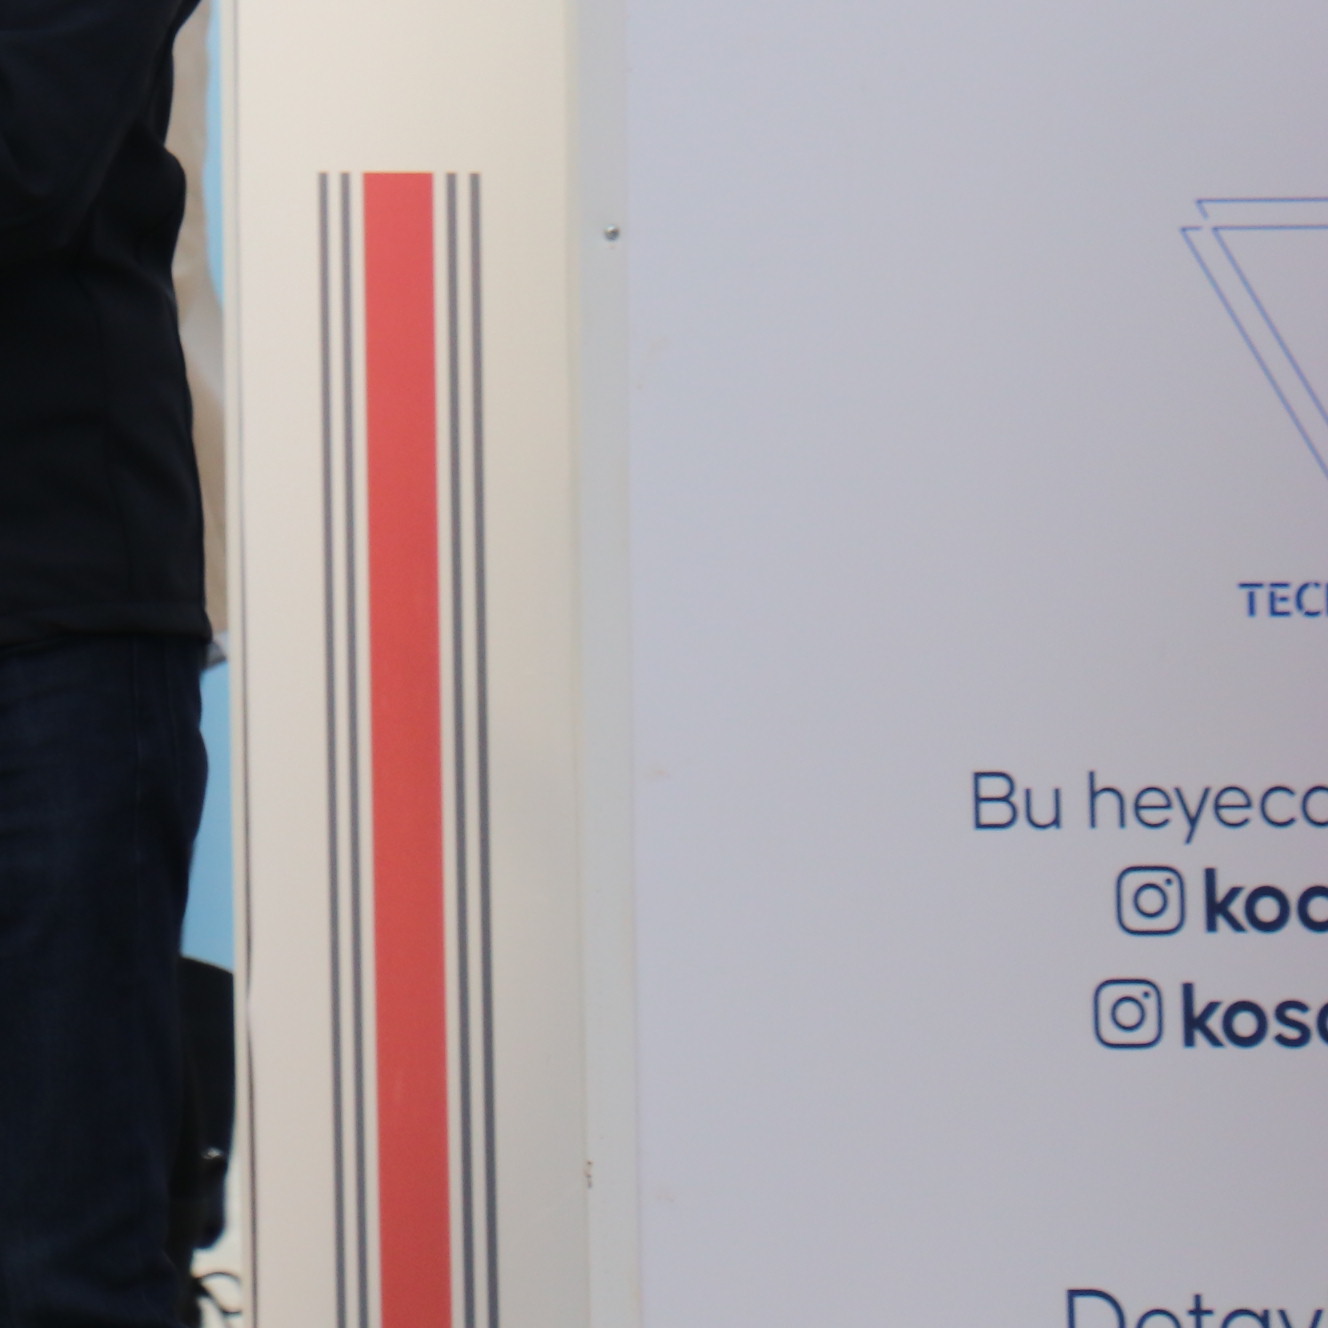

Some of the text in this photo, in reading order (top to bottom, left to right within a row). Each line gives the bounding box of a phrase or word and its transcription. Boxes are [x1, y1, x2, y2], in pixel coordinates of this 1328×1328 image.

[1237, 581, 1328, 618] TEC
[972, 770, 1063, 831] Bu
[1181, 981, 1328, 1050] kos
